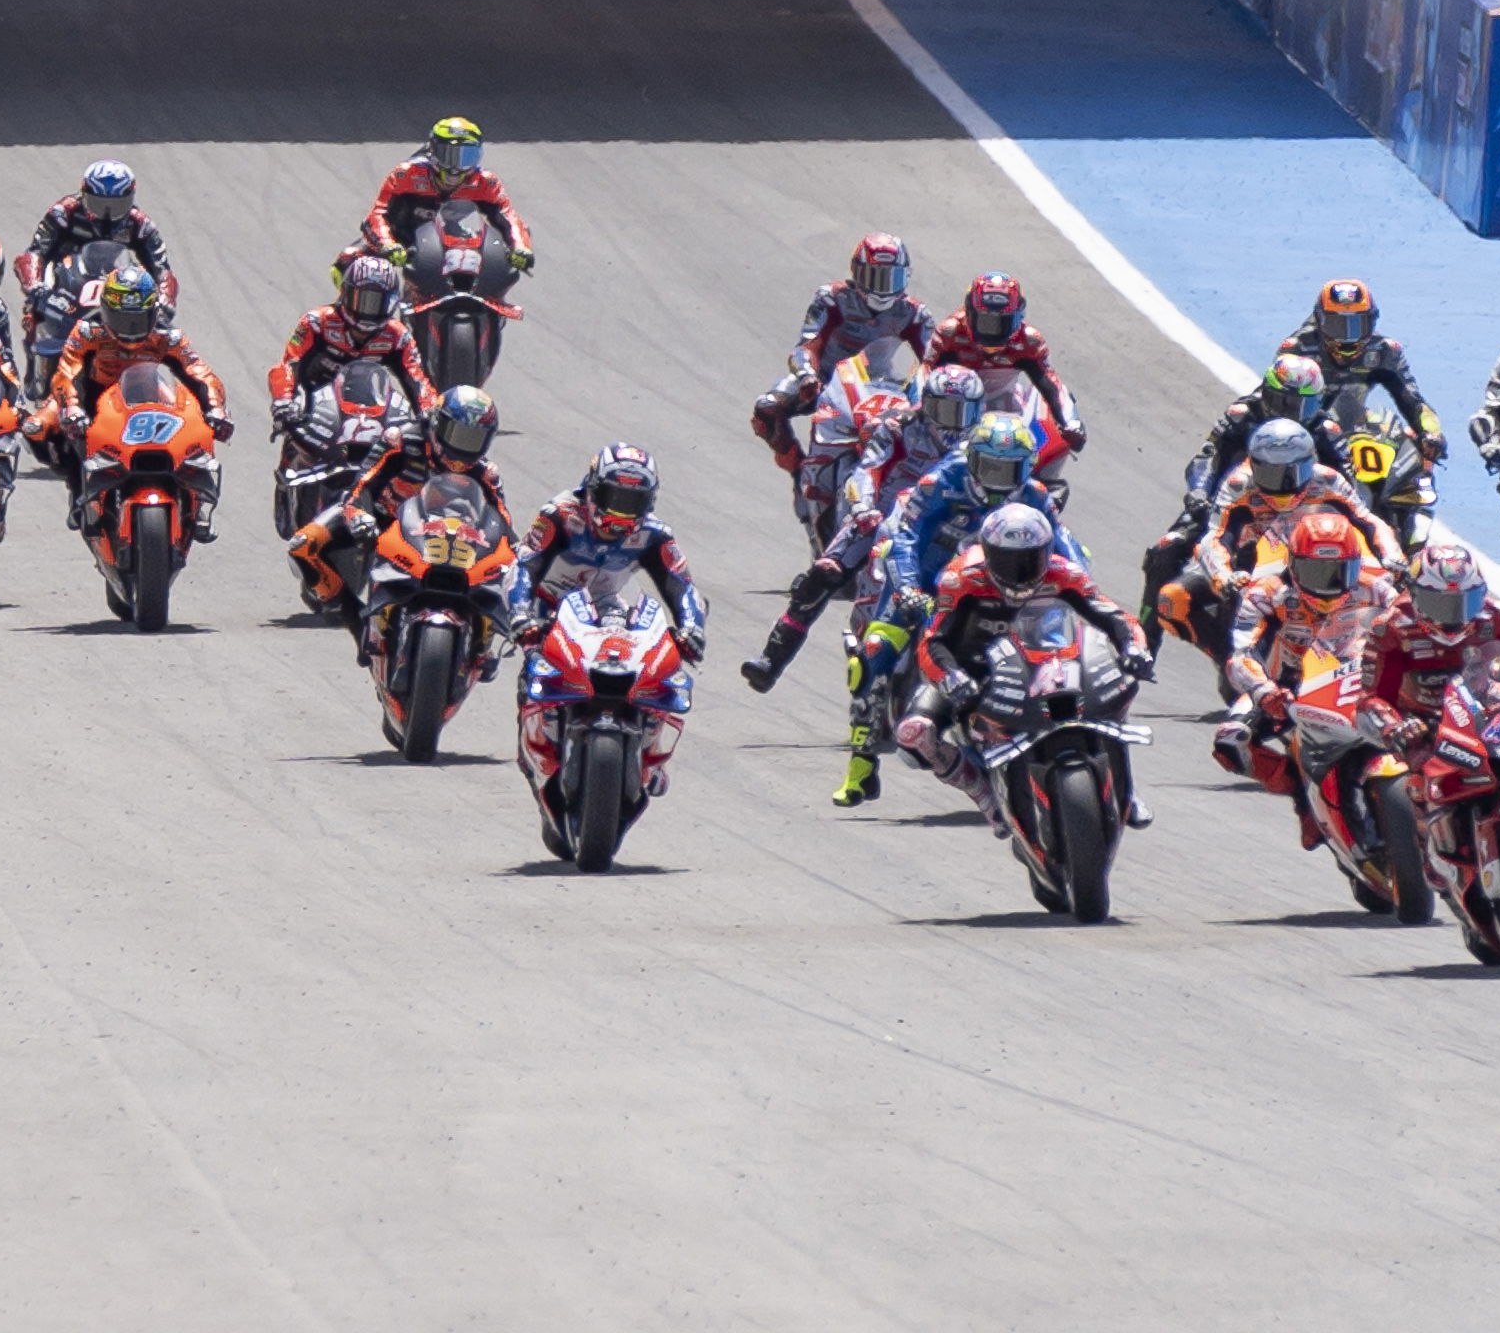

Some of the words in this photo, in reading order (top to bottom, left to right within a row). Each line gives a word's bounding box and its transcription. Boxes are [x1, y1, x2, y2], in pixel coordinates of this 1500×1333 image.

[121, 410, 184, 444] 87
[336, 417, 384, 445] 12
[1438, 739, 1483, 768] Lenovo
